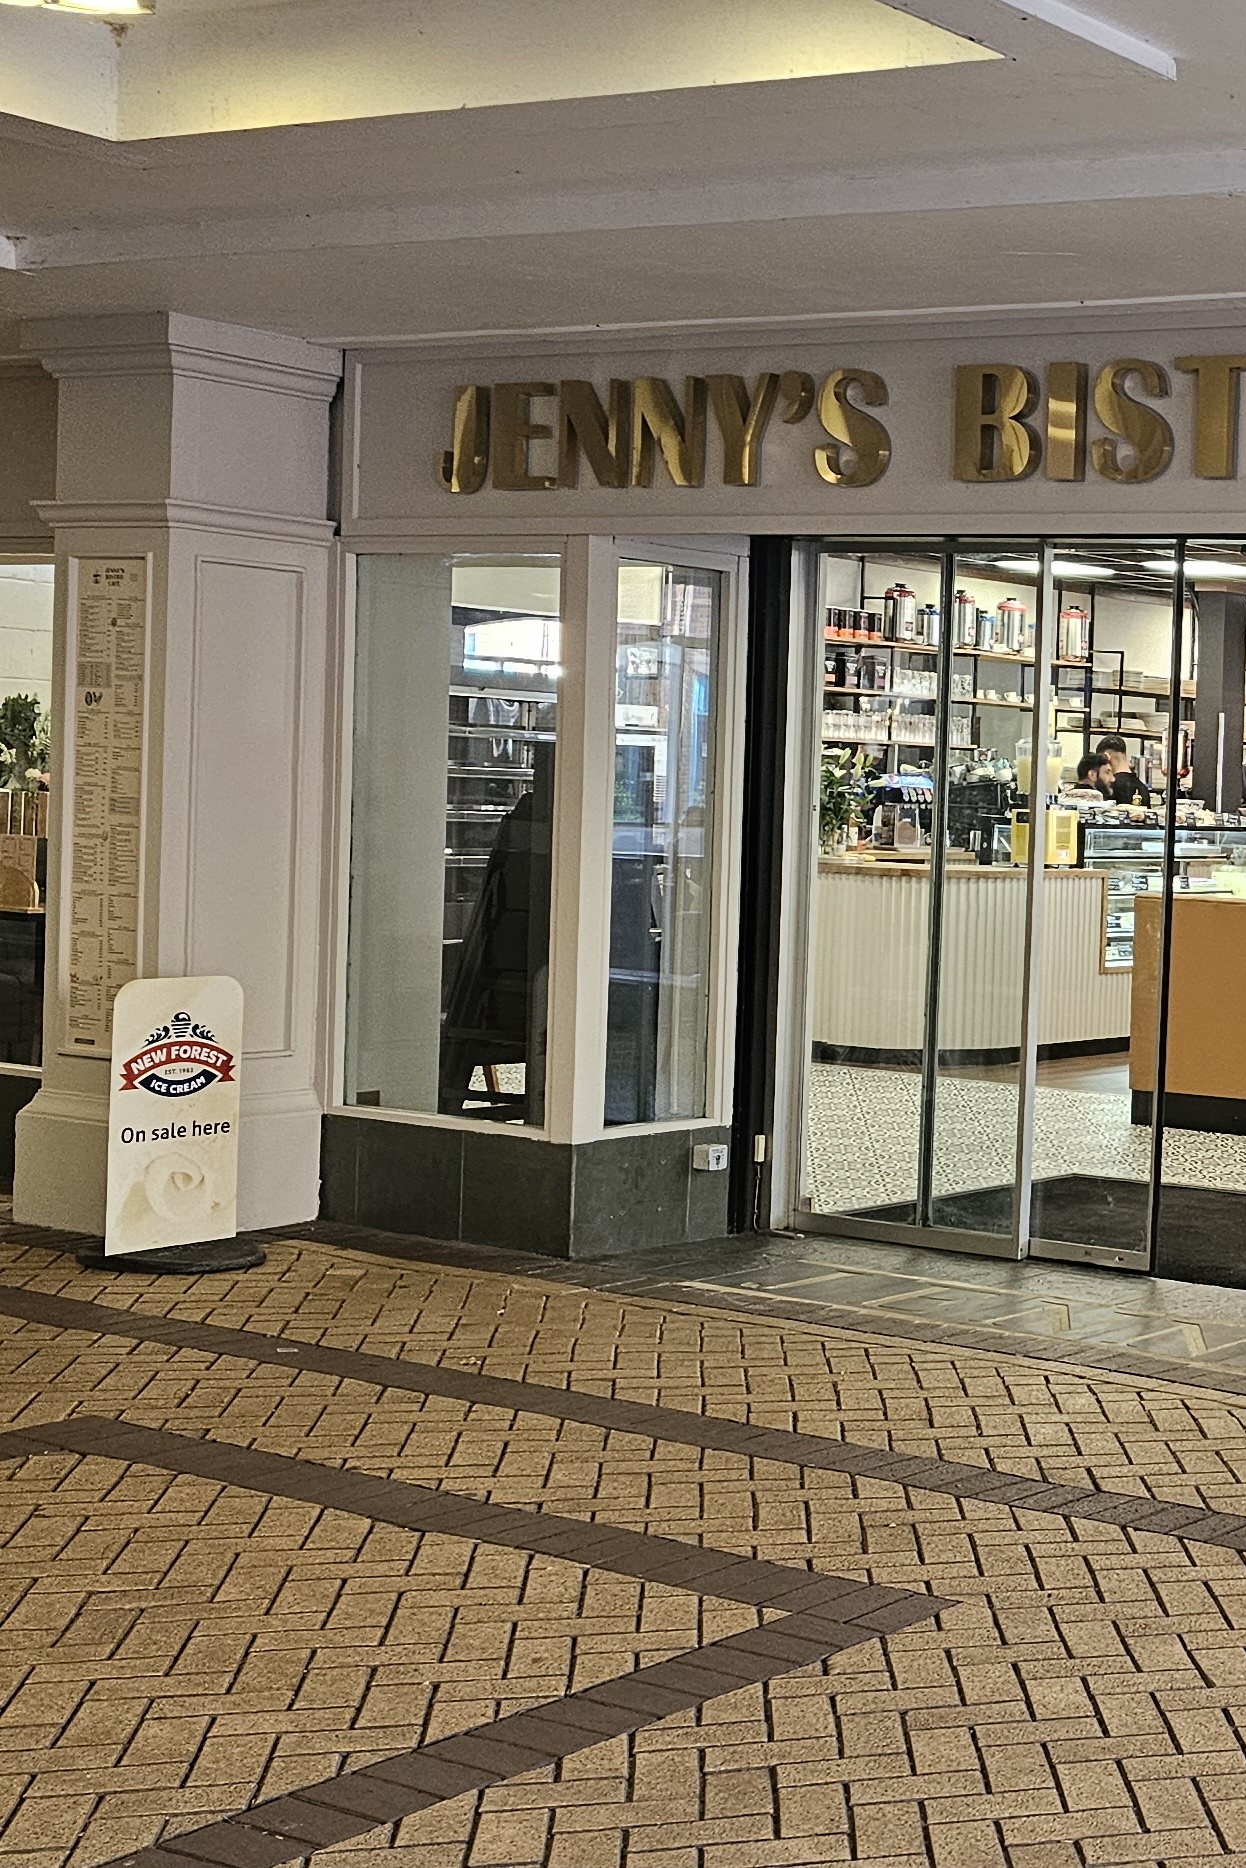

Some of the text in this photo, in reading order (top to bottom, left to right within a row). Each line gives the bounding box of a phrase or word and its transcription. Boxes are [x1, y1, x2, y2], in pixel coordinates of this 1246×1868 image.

[435, 367, 891, 494] JENNY'S
[130, 1045, 227, 1075] NEW FOREST
[150, 1075, 206, 1093] ICE CREAM
[121, 1120, 230, 1143] On sale here
